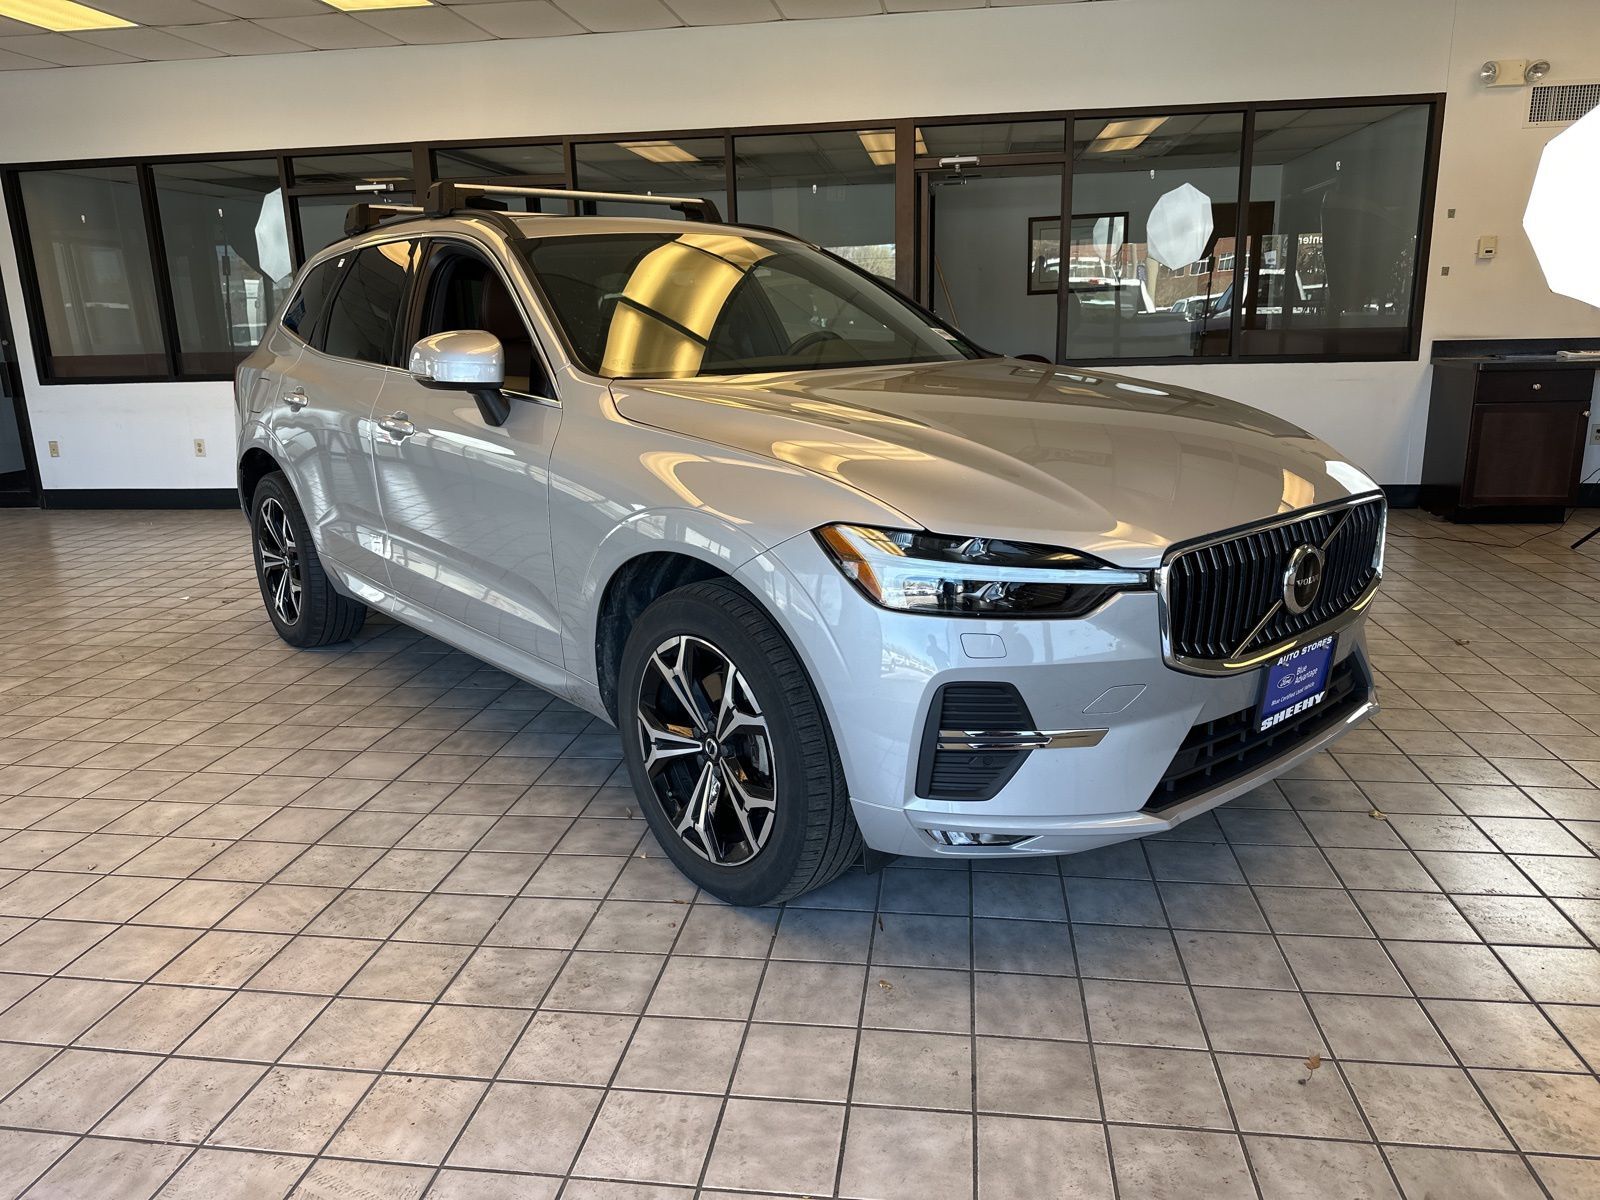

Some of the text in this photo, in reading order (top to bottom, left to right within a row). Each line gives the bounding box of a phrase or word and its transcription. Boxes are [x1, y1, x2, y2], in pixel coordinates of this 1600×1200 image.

[1277, 636, 1333, 665] AUTO STORES
[1294, 667, 1318, 685] Advantage
[1296, 665, 1308, 676] Blue
[1260, 691, 1326, 732] SHEEHY
